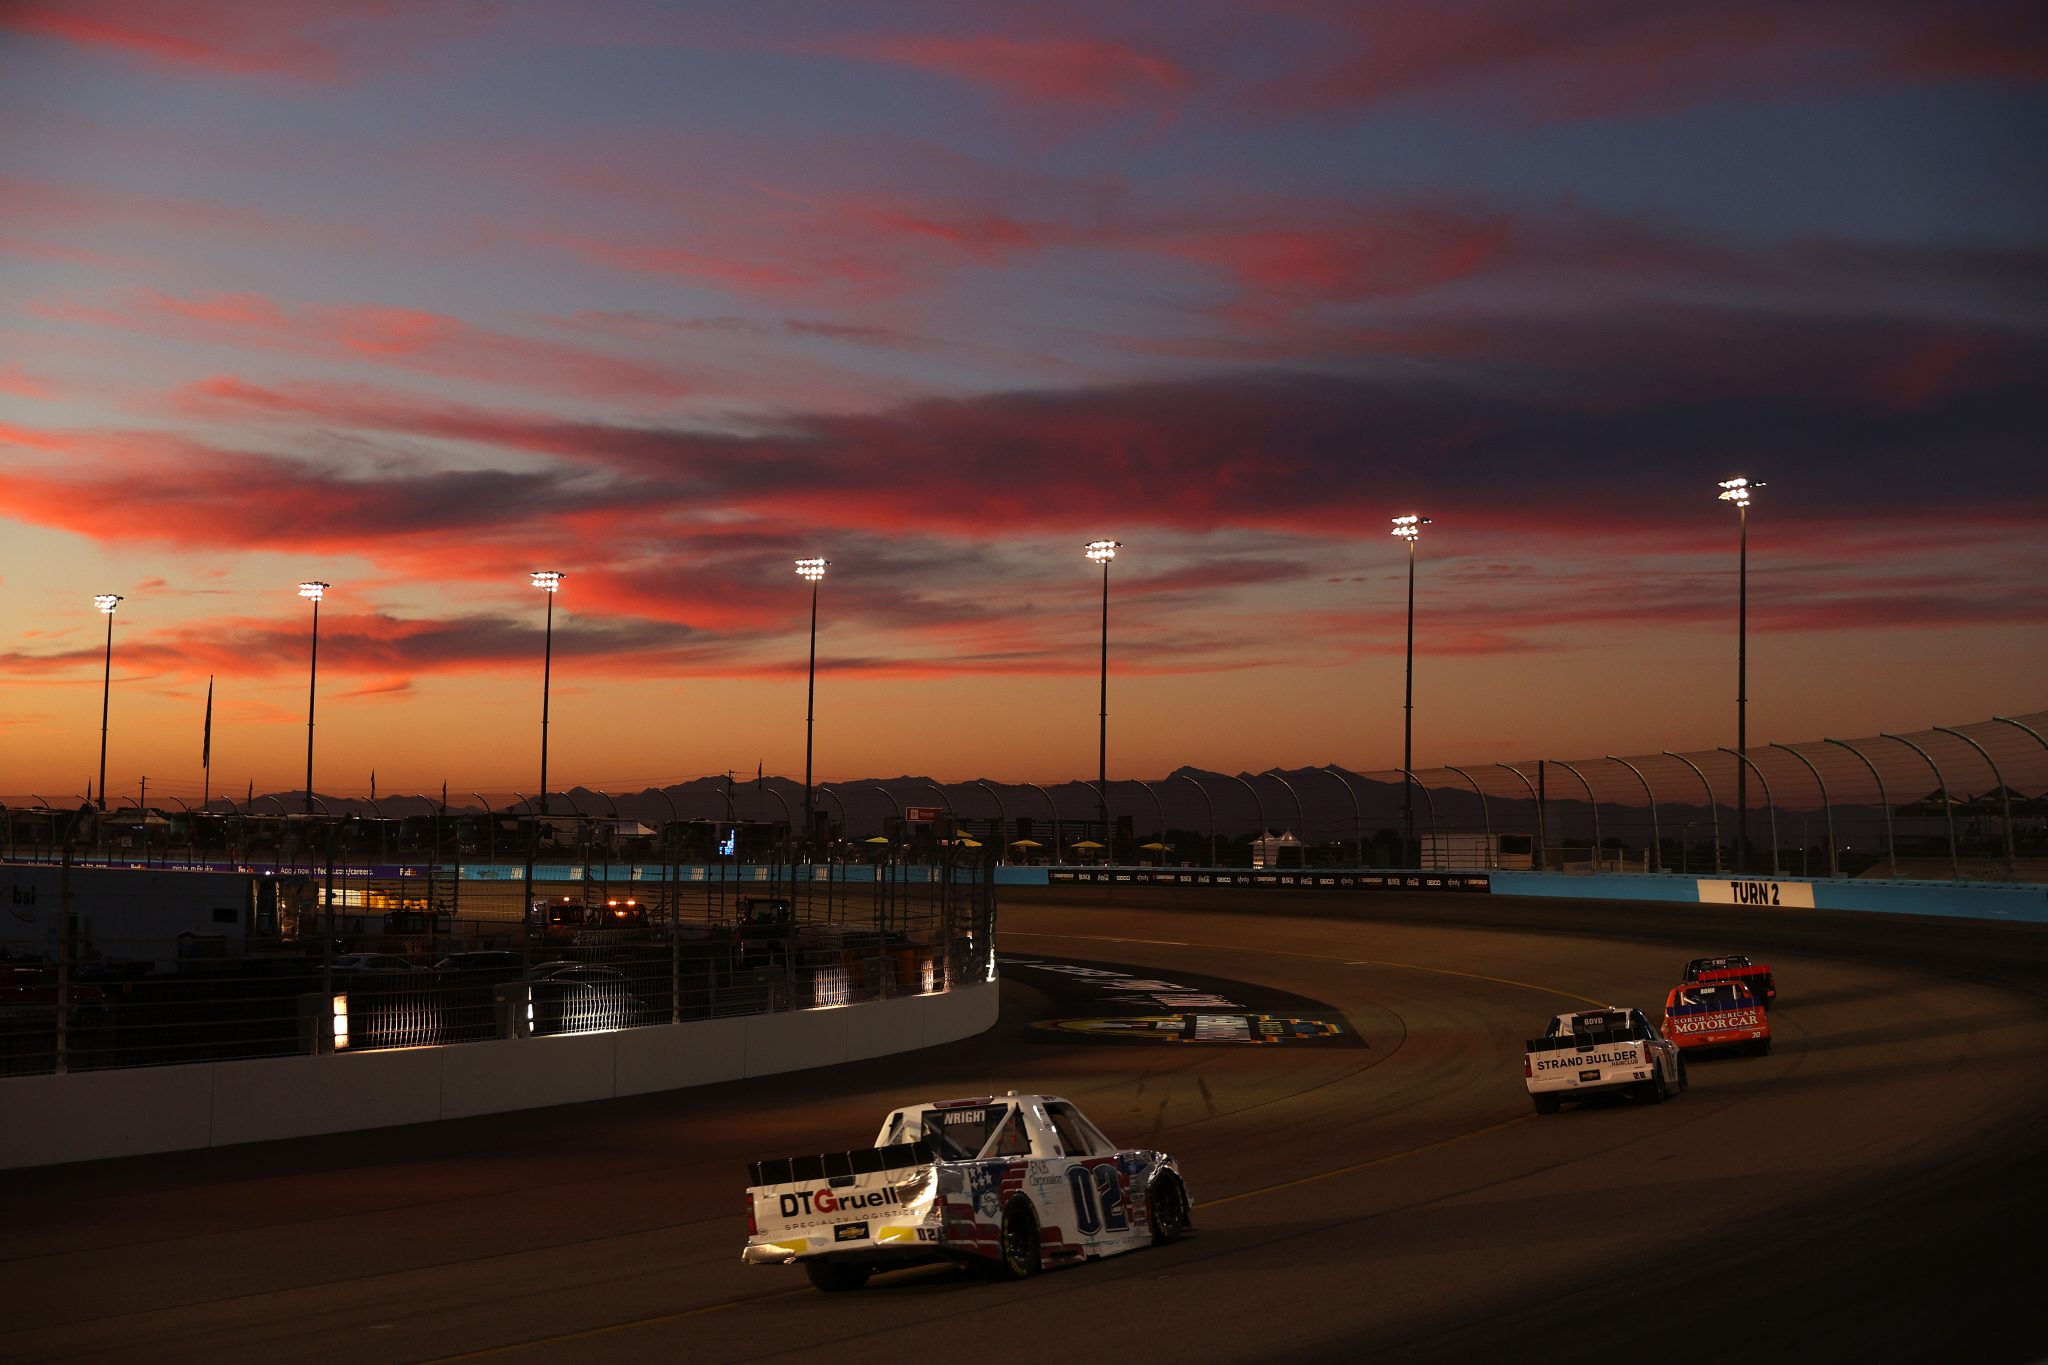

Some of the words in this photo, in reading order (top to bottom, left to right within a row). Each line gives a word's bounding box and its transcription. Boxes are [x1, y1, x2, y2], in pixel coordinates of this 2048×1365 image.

[13, 884, 36, 905] bsi
[1731, 882, 1768, 905] TURN
[1771, 883, 1779, 905] 2
[1584, 1017, 1604, 1026] BOYD
[1674, 1014, 1705, 1025] NORTH
[1709, 1009, 1757, 1021] AMERICAN
[1675, 1019, 1727, 1034] MOTOR
[1728, 1015, 1759, 1028] CAR
[1537, 1057, 1583, 1071] STRAND
[1586, 1050, 1638, 1065] BUILDER
[1065, 1162, 1129, 1236] 02
[784, 1216, 850, 1231] SPECIALTY
